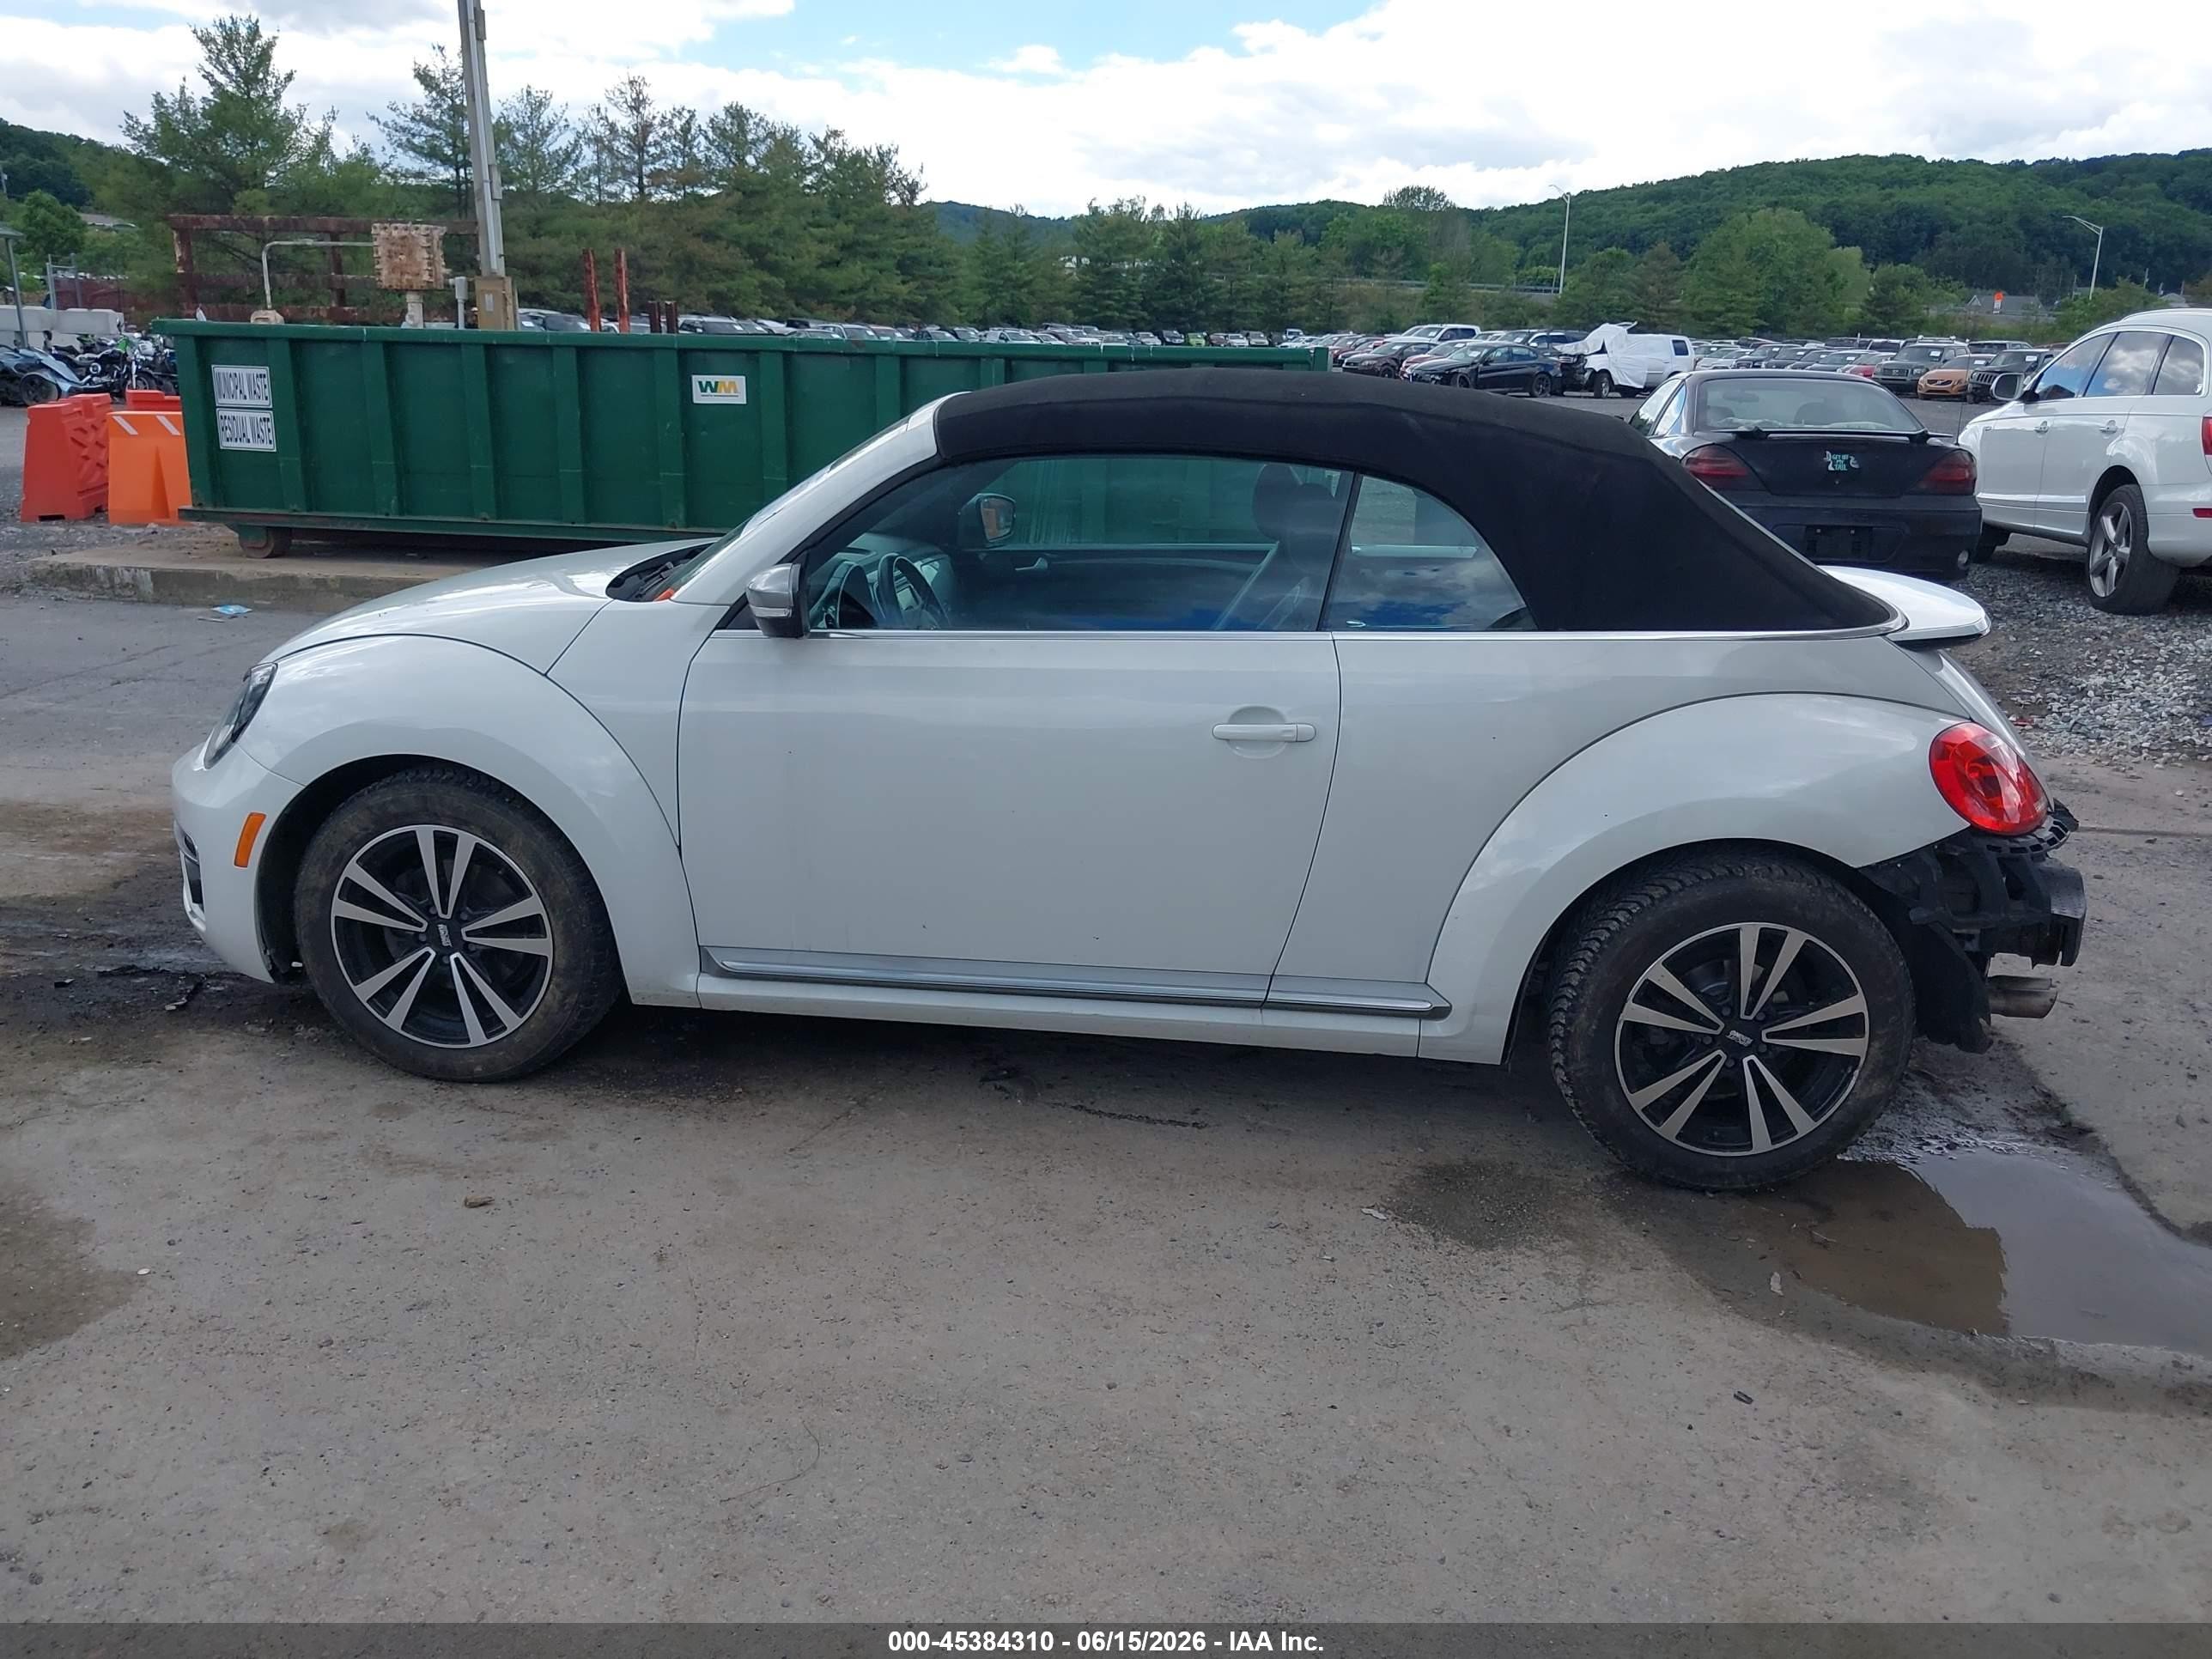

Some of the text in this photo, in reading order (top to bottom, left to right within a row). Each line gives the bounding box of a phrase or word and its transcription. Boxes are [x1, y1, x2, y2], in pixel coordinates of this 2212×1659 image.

[246, 372, 269, 401] WASTE
[697, 380, 738, 393] WM
[219, 415, 273, 445] RESIDUAL WASTE
